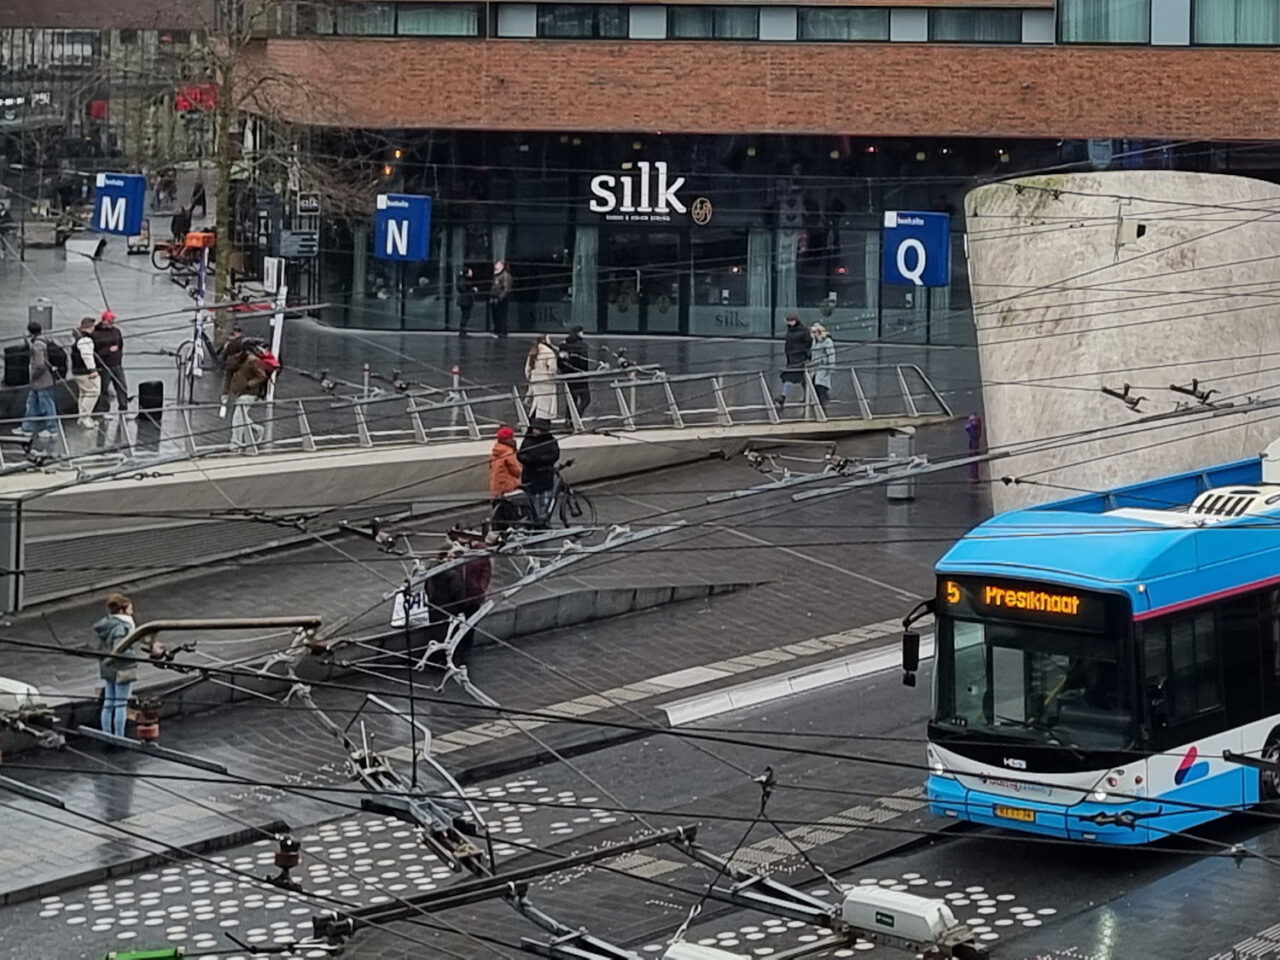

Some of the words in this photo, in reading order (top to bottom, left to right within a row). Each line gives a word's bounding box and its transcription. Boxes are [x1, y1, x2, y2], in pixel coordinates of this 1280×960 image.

[589, 161, 687, 213] silk
[99, 195, 127, 231] M
[386, 218, 409, 256] N
[896, 238, 927, 286] Q
[945, 580, 962, 604] 5
